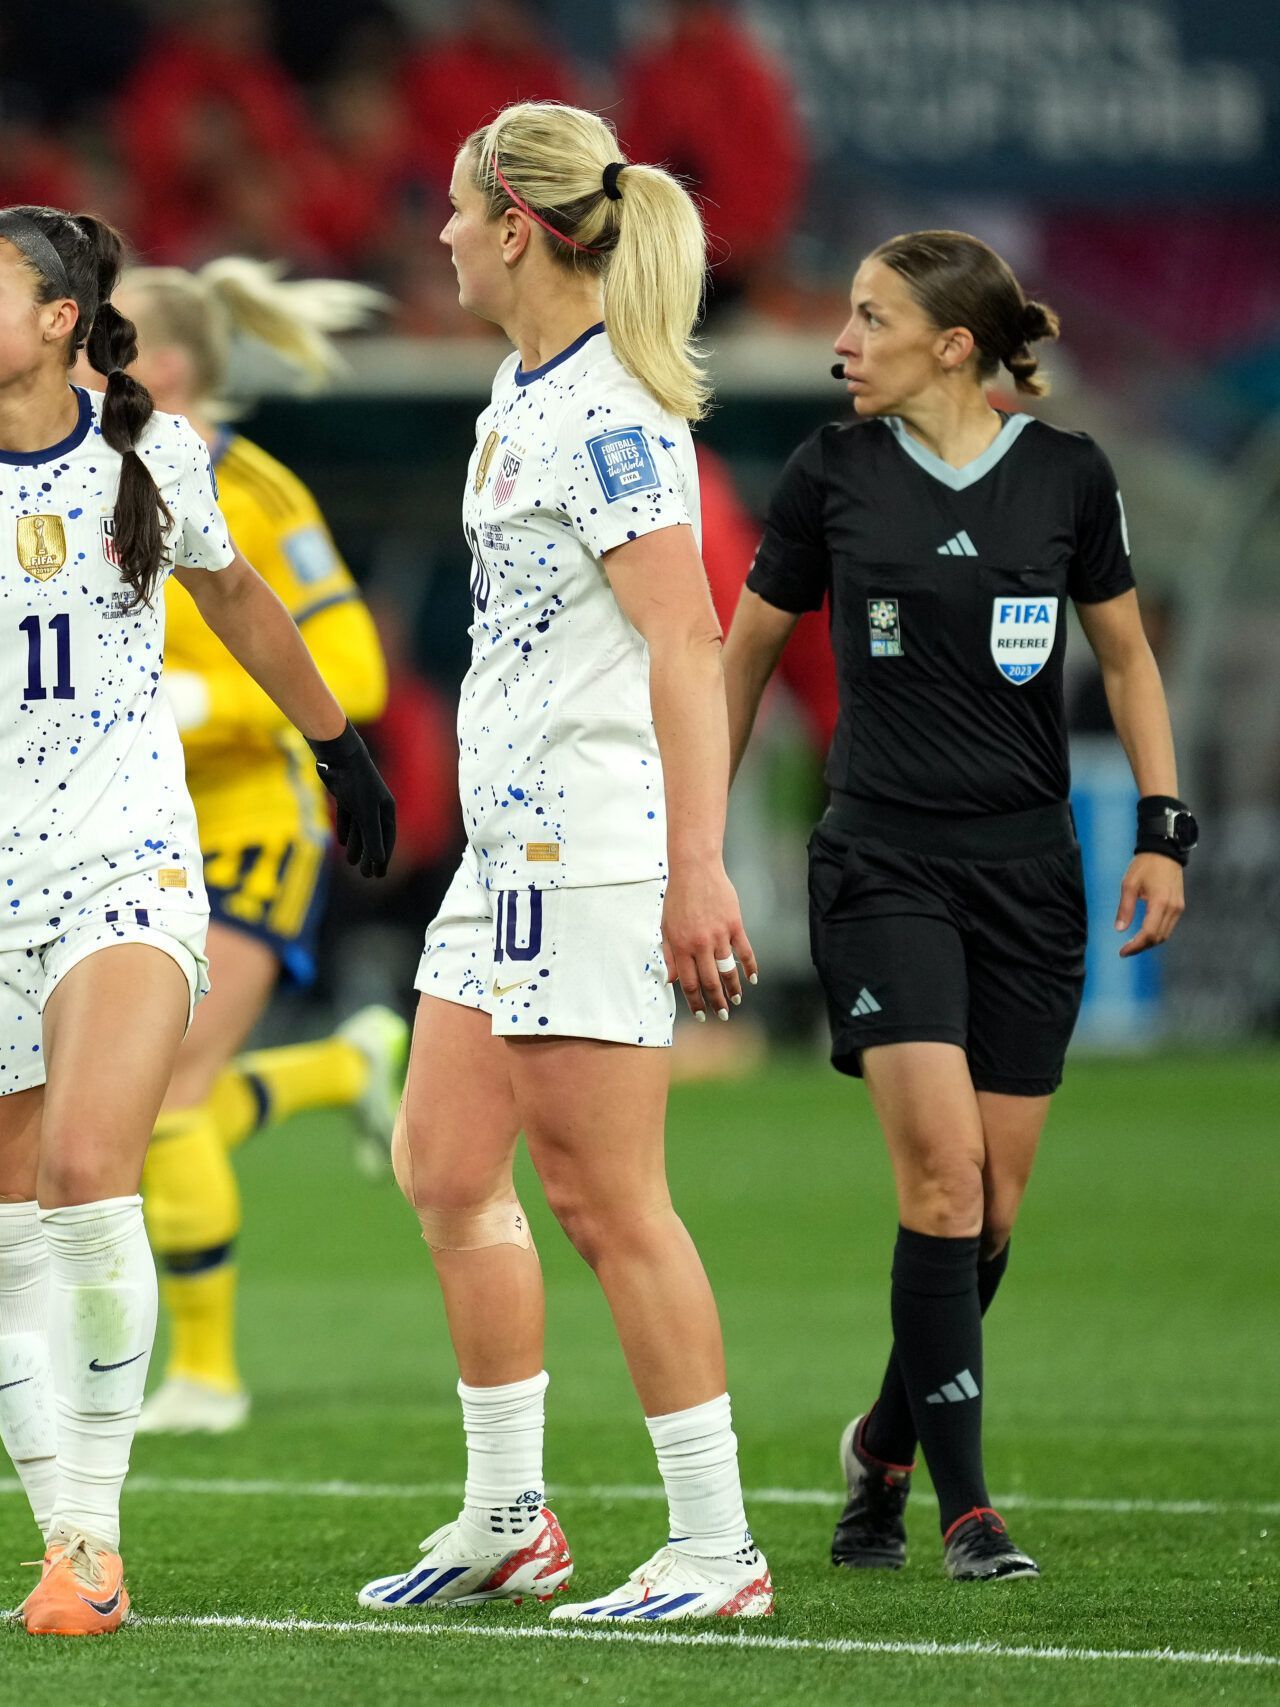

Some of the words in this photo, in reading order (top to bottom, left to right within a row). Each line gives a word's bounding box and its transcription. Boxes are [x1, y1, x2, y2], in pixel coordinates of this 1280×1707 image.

[601, 438, 635, 455] FOOTBALL
[605, 446, 639, 466] UNITES
[503, 454, 520, 478] USA
[607, 465, 621, 477] the
[621, 457, 644, 473] World
[623, 474, 638, 482] FIFA
[999, 604, 1050, 624] FIFA
[997, 638, 1048, 649] REFEREE
[19, 613, 76, 700] 11
[1009, 666, 1032, 676] 2023
